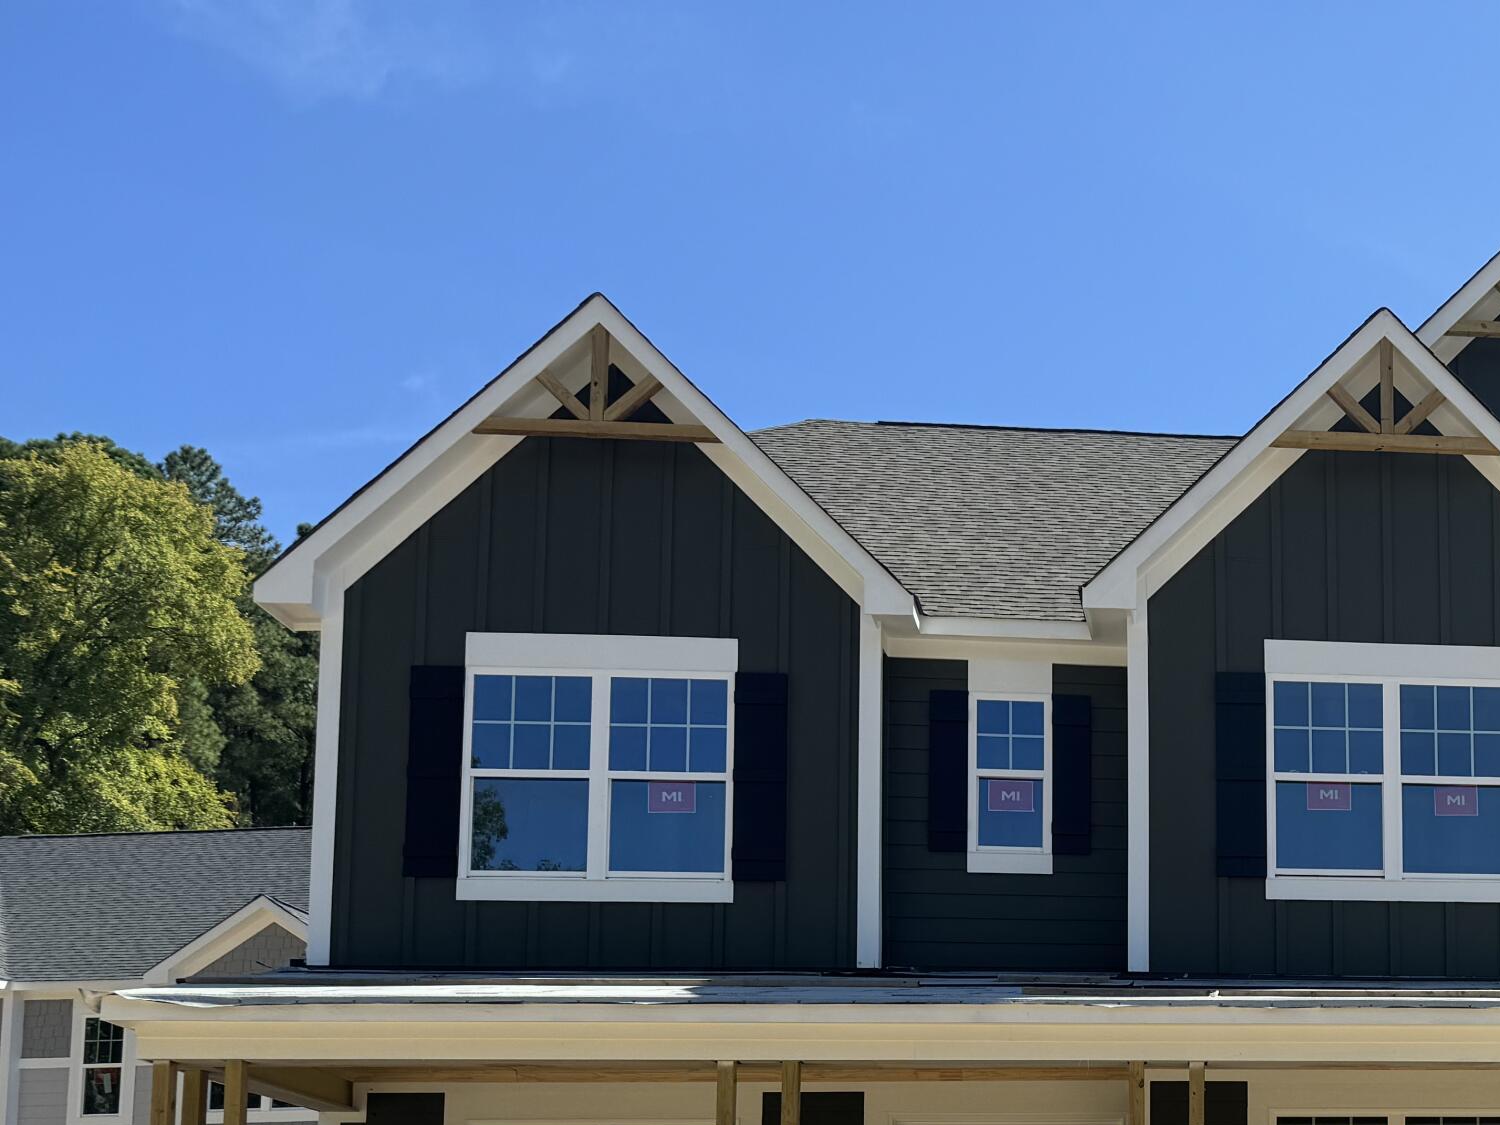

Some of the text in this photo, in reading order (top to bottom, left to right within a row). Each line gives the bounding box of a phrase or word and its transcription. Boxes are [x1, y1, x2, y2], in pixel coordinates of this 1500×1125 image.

[661, 791, 682, 803] MI
[1001, 790, 1021, 801] MI
[1319, 789, 1339, 800] MI
[1446, 794, 1466, 806] MI
